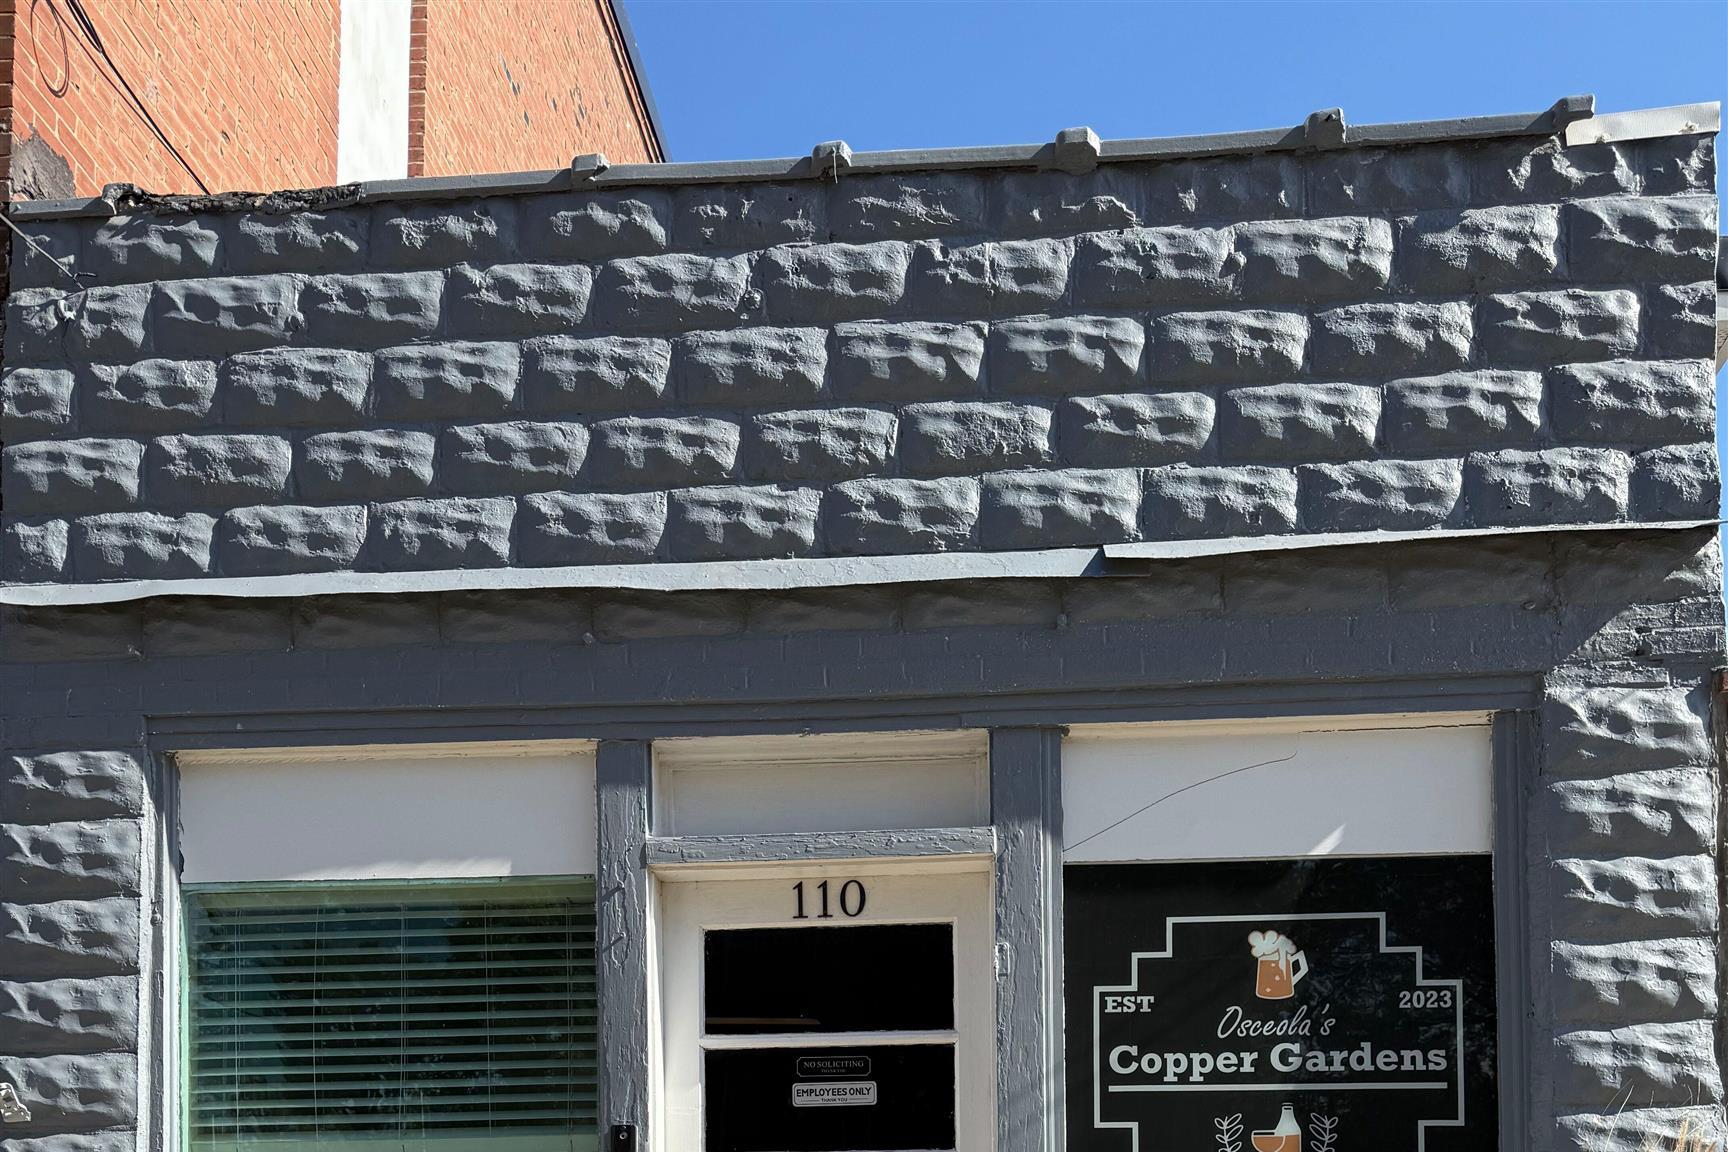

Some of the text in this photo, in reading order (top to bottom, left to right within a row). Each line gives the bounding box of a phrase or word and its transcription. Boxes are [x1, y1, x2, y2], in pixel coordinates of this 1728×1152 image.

[792, 880, 867, 919] 110
[1104, 996, 1155, 1013] EST
[1398, 990, 1453, 1009] 2023
[1216, 1003, 1336, 1039] Osceola's
[803, 1061, 816, 1069] NO
[1108, 1041, 1448, 1082] Copper Gardens
[796, 1086, 871, 1098] EMPLOYEES ONLY
